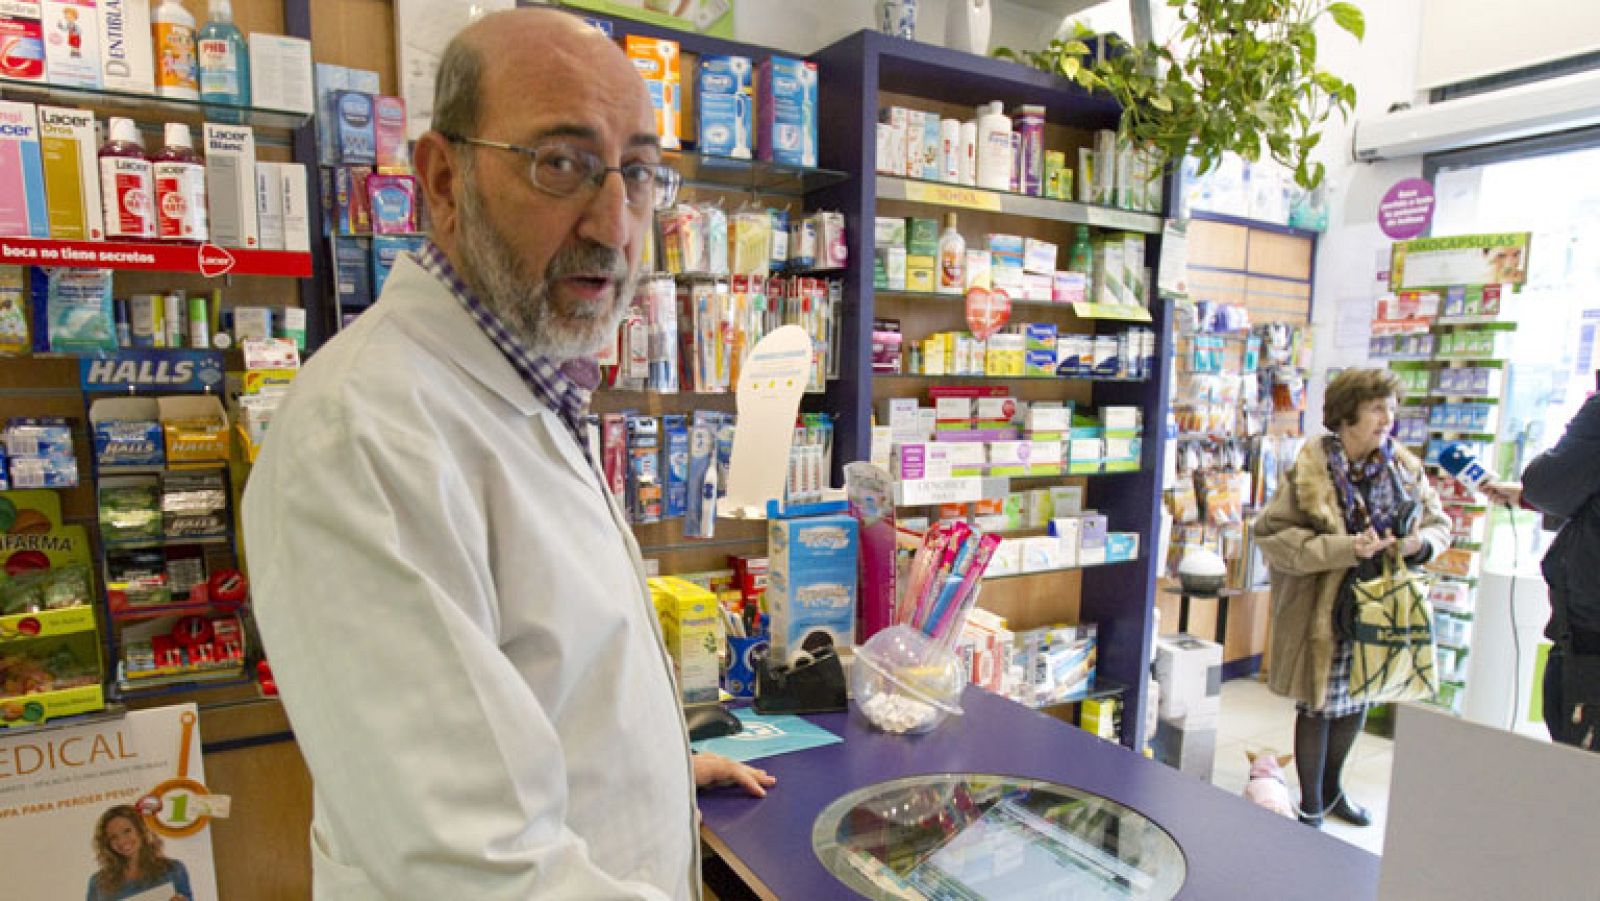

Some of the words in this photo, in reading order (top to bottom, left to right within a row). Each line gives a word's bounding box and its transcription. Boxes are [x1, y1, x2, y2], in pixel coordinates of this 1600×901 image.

[203, 43, 226, 53] PHB
[41, 109, 91, 127] Lacer
[43, 123, 74, 134] Oros
[208, 127, 248, 141] Lacer
[210, 141, 243, 151] Blanc
[115, 159, 148, 172] Lacer
[2, 244, 37, 257] boca
[40, 249, 59, 259] no
[60, 247, 97, 261] tiene
[99, 251, 155, 264] secretos
[87, 360, 195, 384] HALLS
[167, 794, 188, 822] 1
